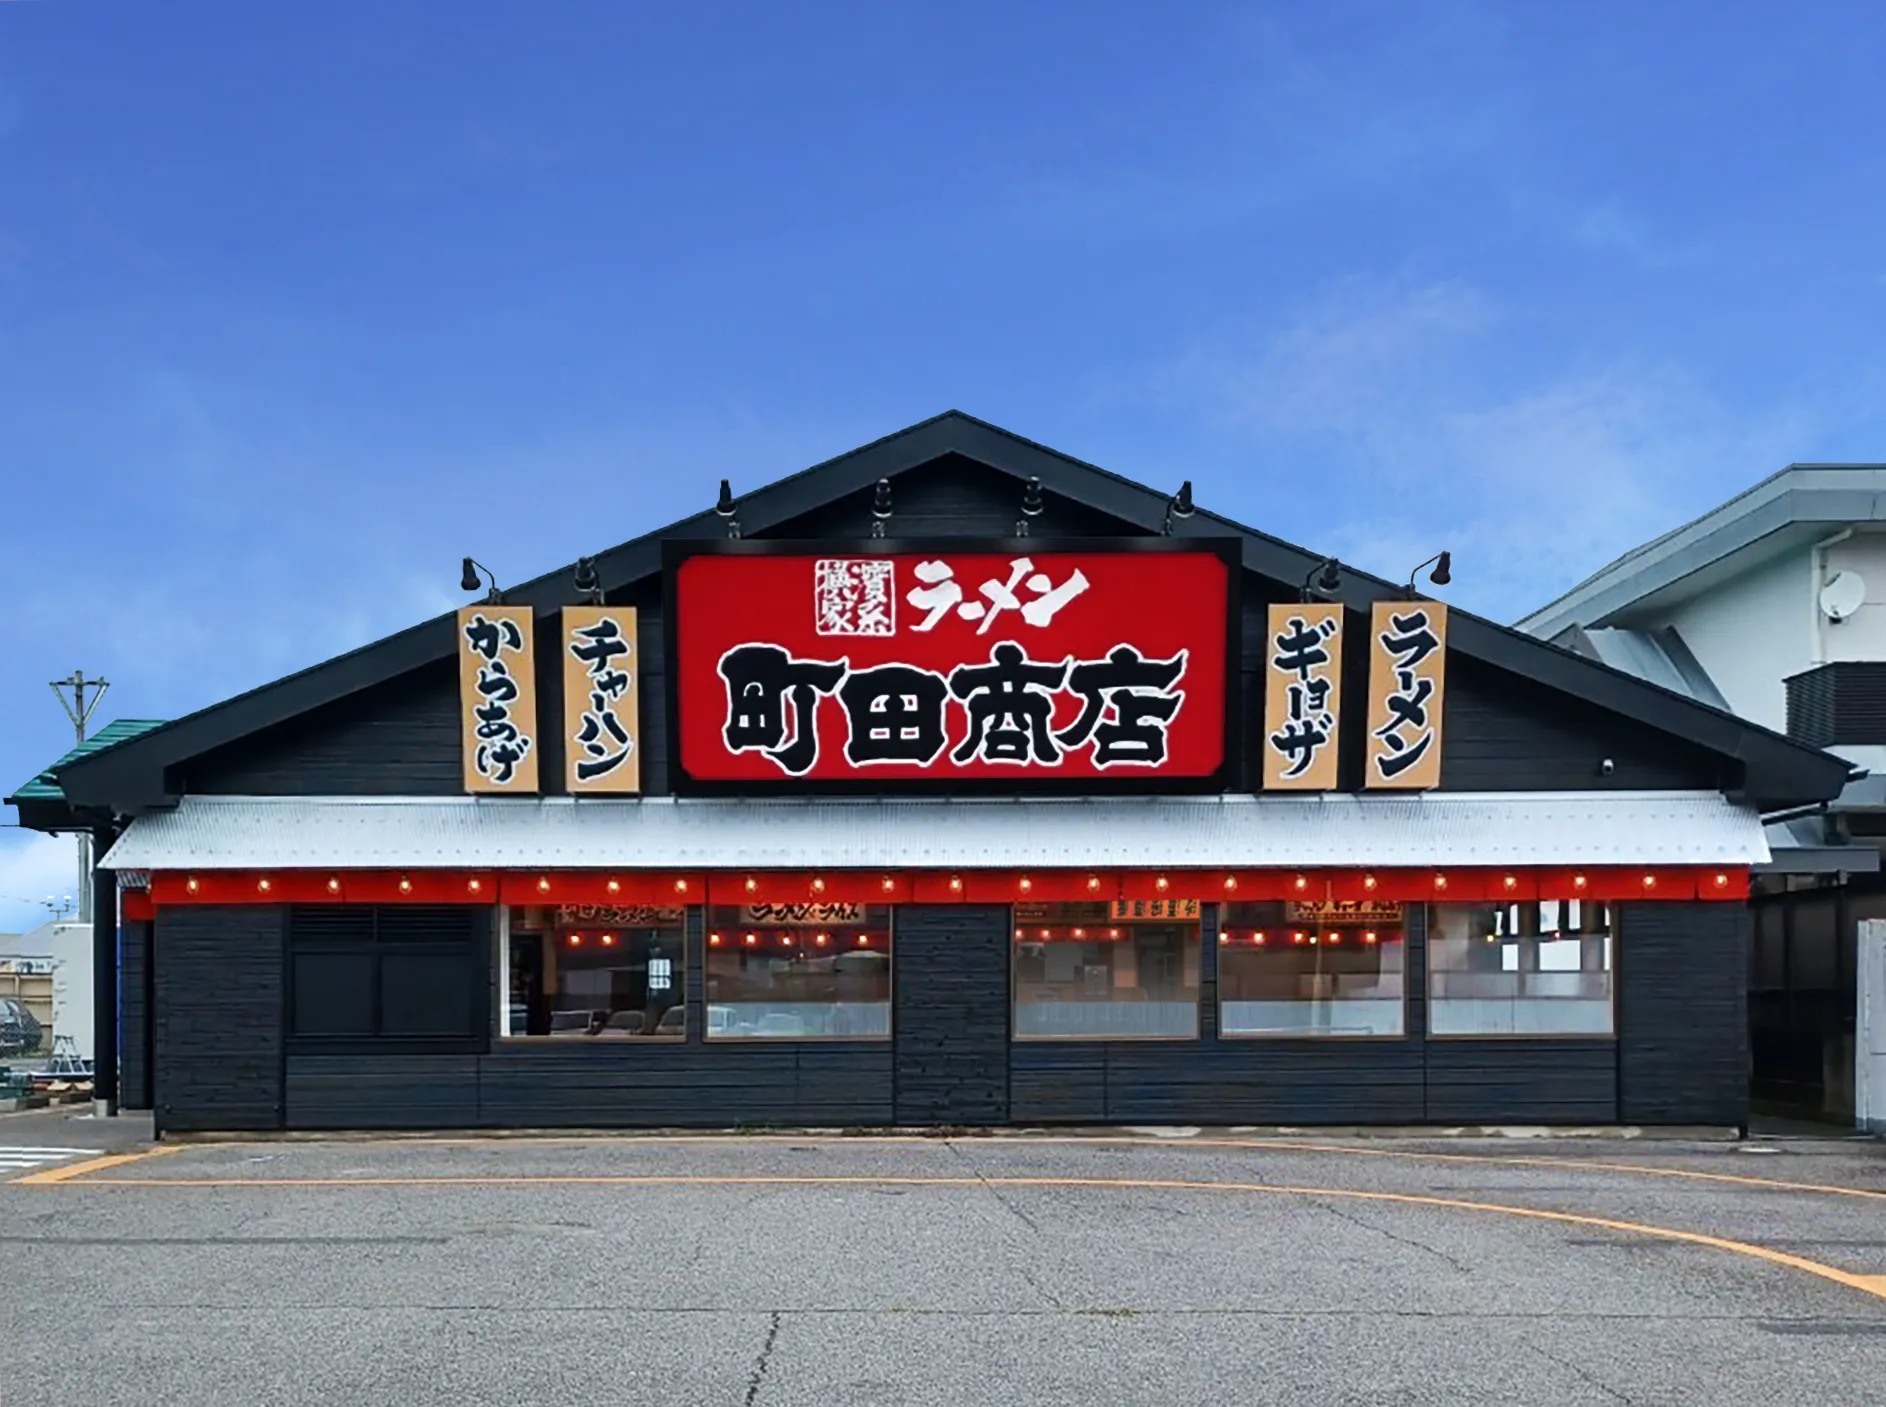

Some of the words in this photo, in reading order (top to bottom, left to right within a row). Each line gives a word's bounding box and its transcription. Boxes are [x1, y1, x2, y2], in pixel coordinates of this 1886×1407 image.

[906, 557, 1090, 635] ラーメン
[464, 614, 531, 786] からあげ
[569, 617, 633, 781] チャーハン
[717, 640, 1189, 775] 町田商店
[1270, 616, 1337, 778] ギョーザ
[1372, 610, 1440, 779] ラーメン
